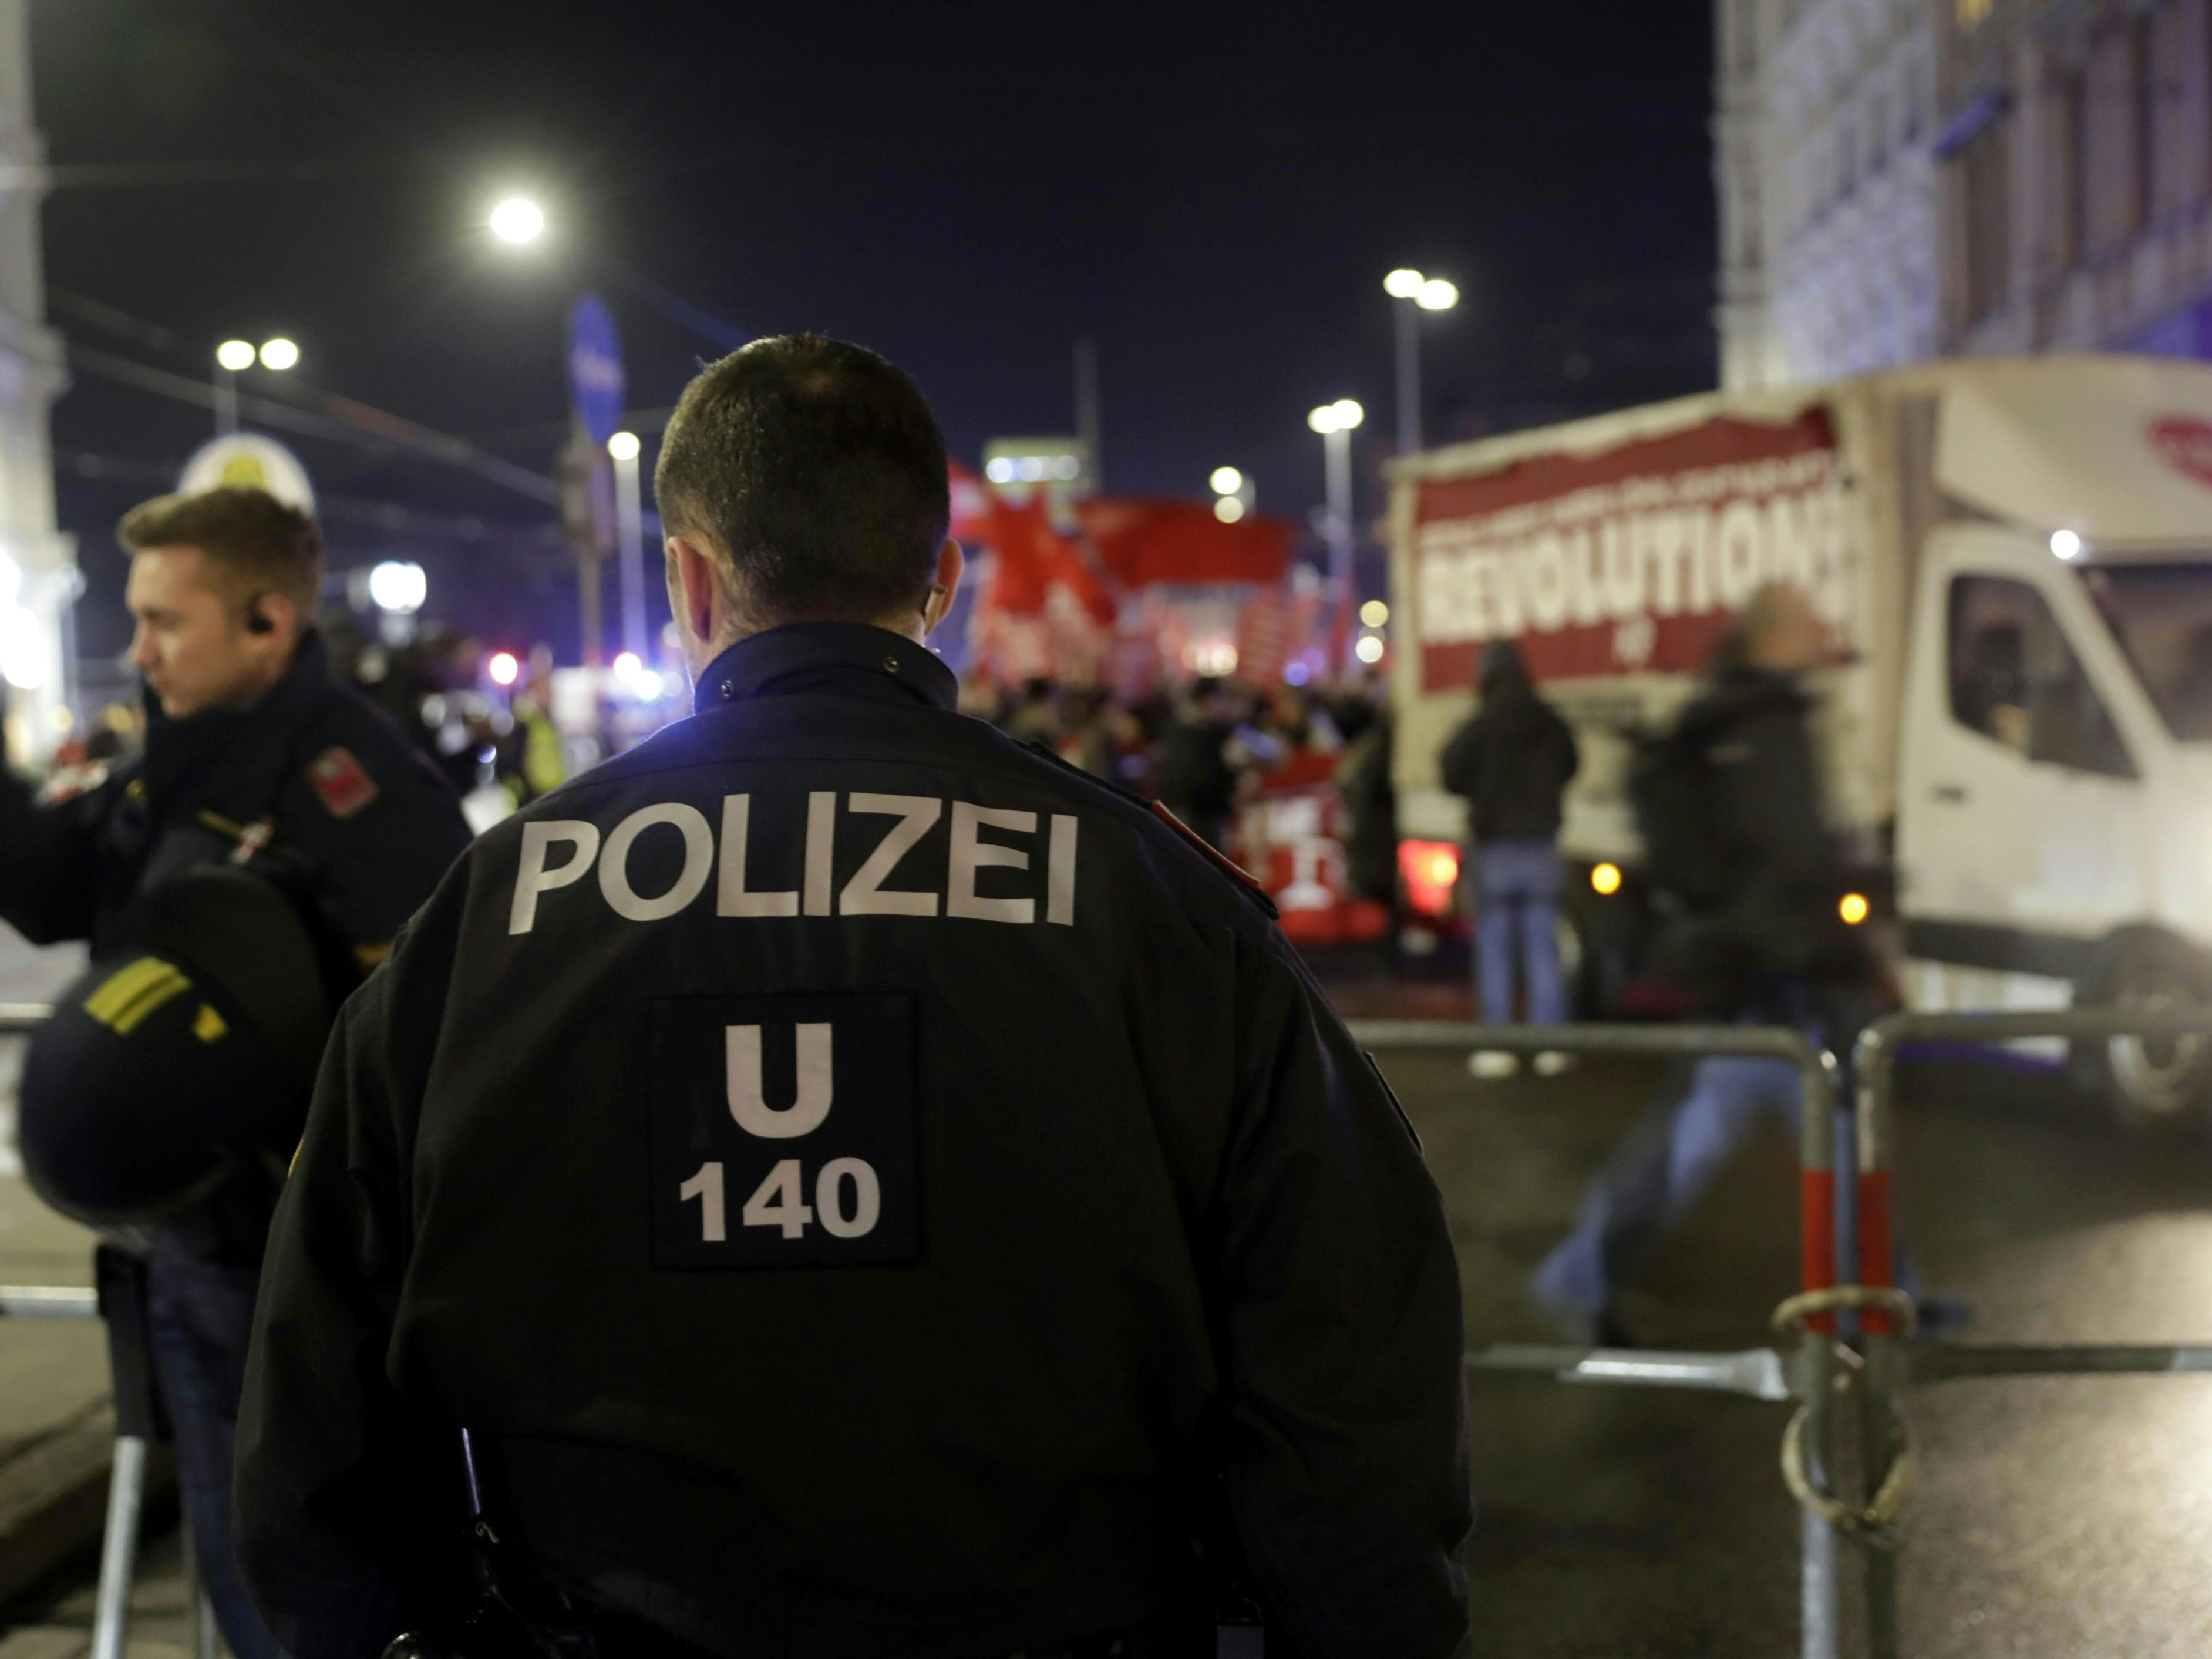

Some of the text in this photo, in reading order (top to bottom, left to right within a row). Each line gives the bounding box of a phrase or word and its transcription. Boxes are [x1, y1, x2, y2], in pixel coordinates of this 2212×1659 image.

[509, 791, 1078, 935] POLIZEI
[725, 1022, 833, 1138] U
[680, 1157, 880, 1241] 140
